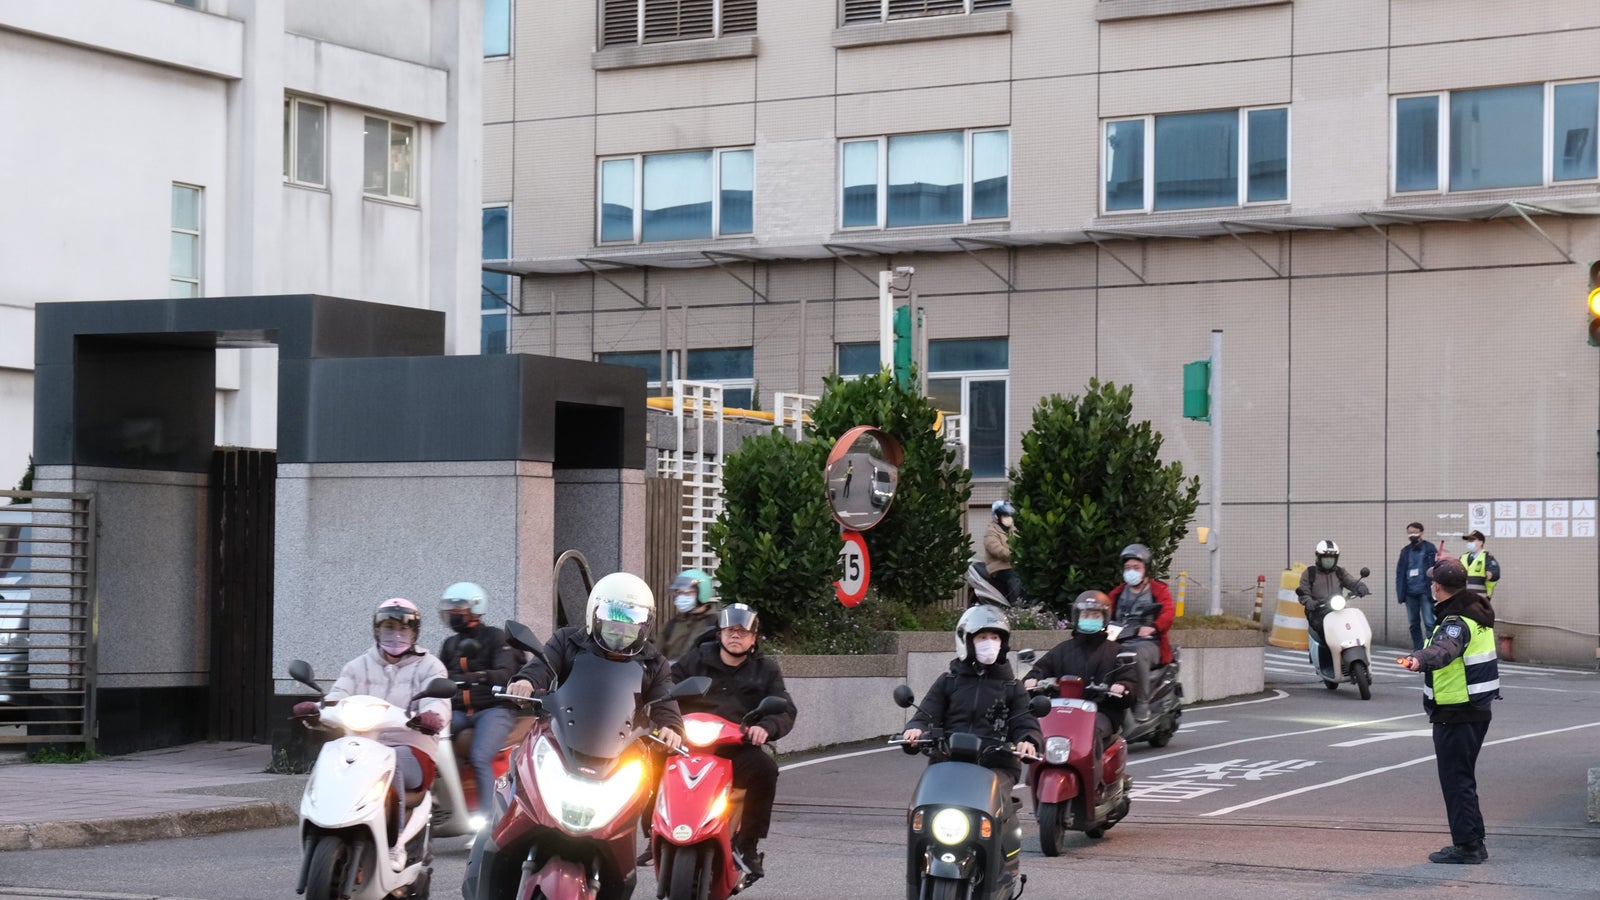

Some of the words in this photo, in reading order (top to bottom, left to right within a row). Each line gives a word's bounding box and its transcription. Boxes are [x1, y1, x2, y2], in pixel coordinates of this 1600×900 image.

[1499, 502, 1591, 517] 注意行人
[1500, 521, 1590, 537] 小心慢行
[838, 553, 860, 581] 15
[1131, 758, 1323, 803] 機車
